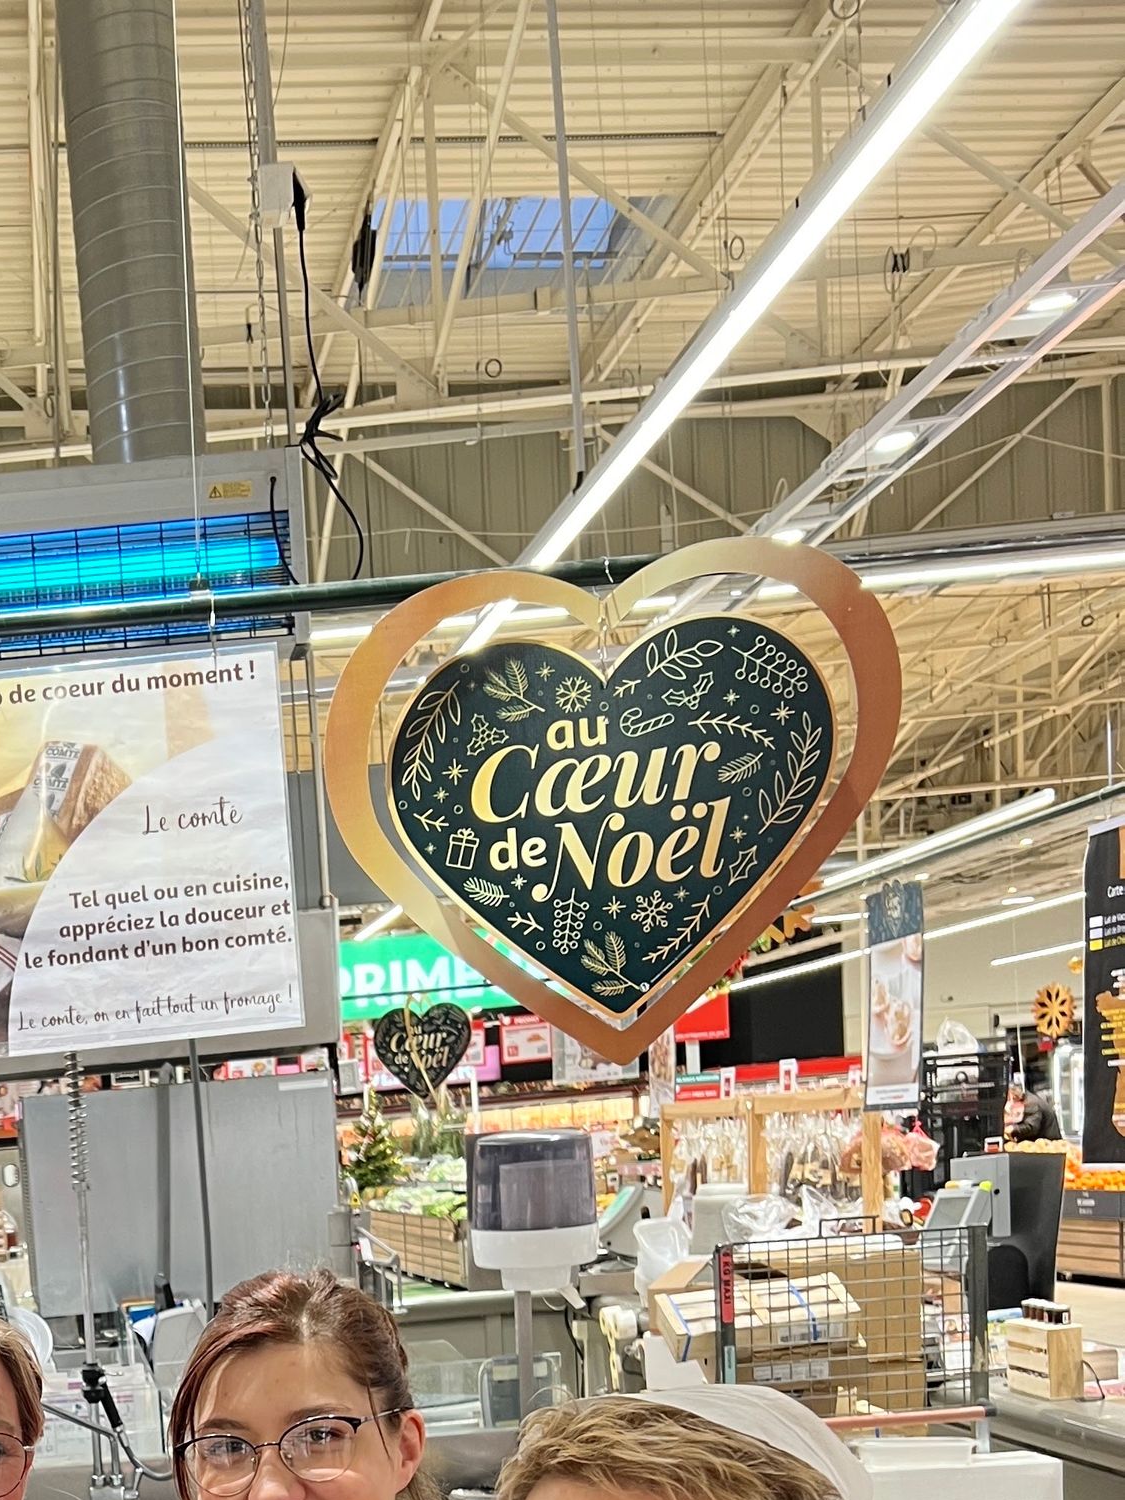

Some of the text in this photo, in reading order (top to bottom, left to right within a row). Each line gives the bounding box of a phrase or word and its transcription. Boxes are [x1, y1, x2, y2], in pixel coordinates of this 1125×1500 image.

[9, 684, 37, 705] de
[42, 680, 105, 701] coeur
[112, 673, 141, 694] du
[147, 666, 244, 690] moment
[248, 660, 255, 680] !
[546, 714, 608, 751] au
[142, 797, 243, 835] Le comté
[489, 796, 732, 902] de Noël
[70, 873, 290, 911] Tel quel ou en cuisine,
[59, 900, 291, 945] appréciez la douceur et
[25, 927, 293, 969] le fondant d'un bon comté.
[18, 1010, 36, 1031] Le
[41, 1005, 88, 1027] comté,
[94, 1009, 110, 1022] on
[115, 1007, 131, 1021] en
[135, 999, 162, 1024] fait
[168, 994, 196, 1015] tout
[201, 1000, 218, 1013] un
[224, 991, 283, 1015] fromage
